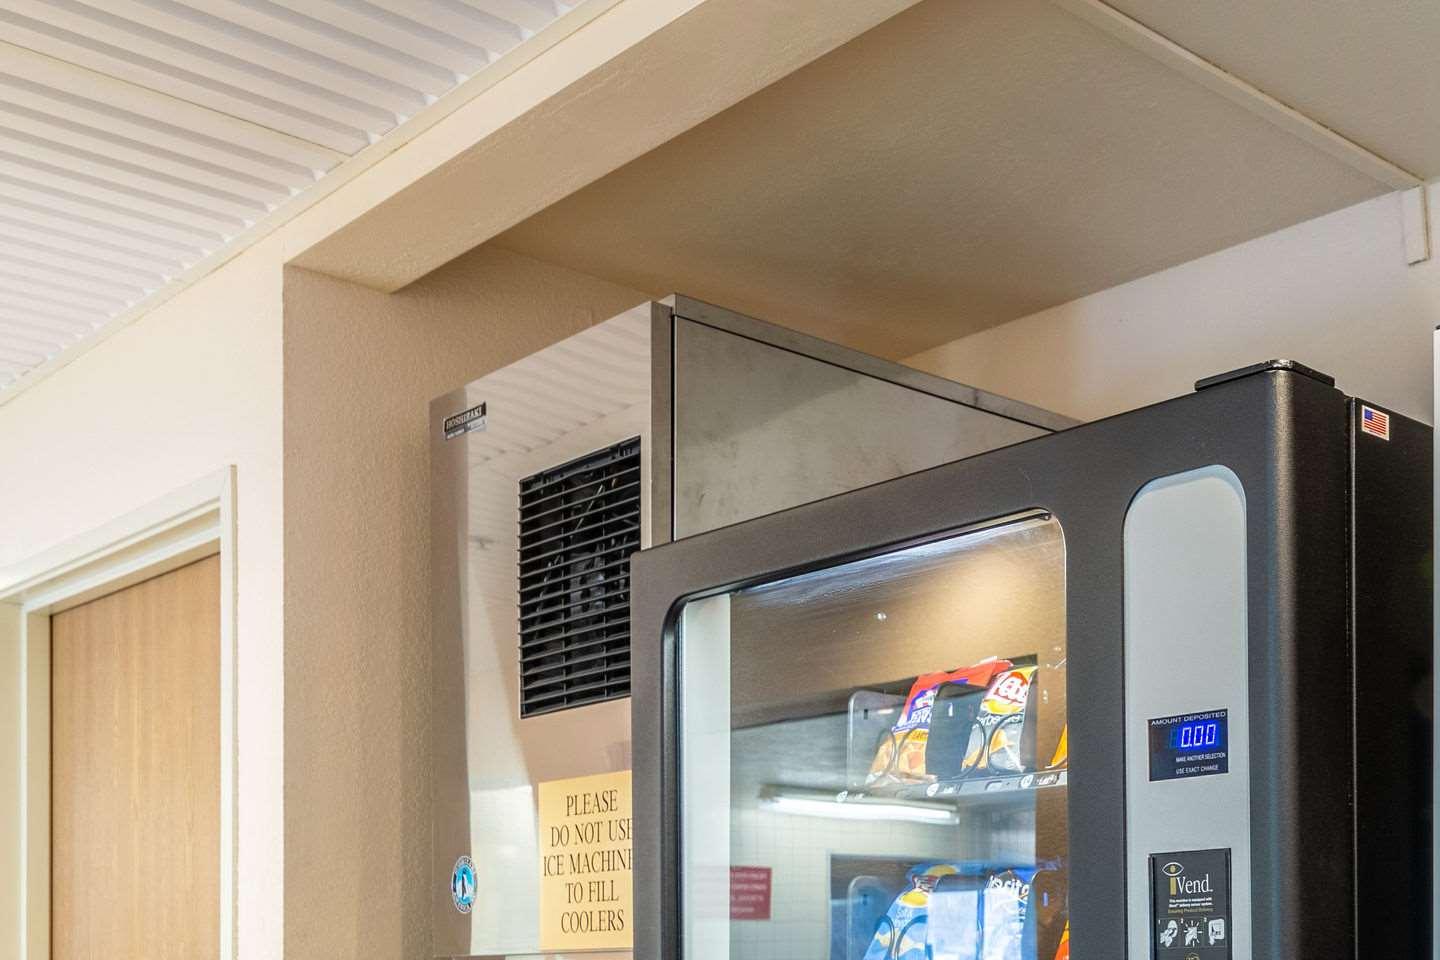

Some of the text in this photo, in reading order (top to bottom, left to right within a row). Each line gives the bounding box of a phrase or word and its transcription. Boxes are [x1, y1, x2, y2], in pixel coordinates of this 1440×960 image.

[1151, 711, 1226, 726] AMOUNT DEPOSITED
[566, 789, 618, 817] PLEASE
[551, 824, 569, 848] DO
[575, 821, 603, 845] NOT
[544, 853, 564, 877] ICE
[565, 880, 619, 904] TO FILL
[561, 909, 624, 934] COOLERS
